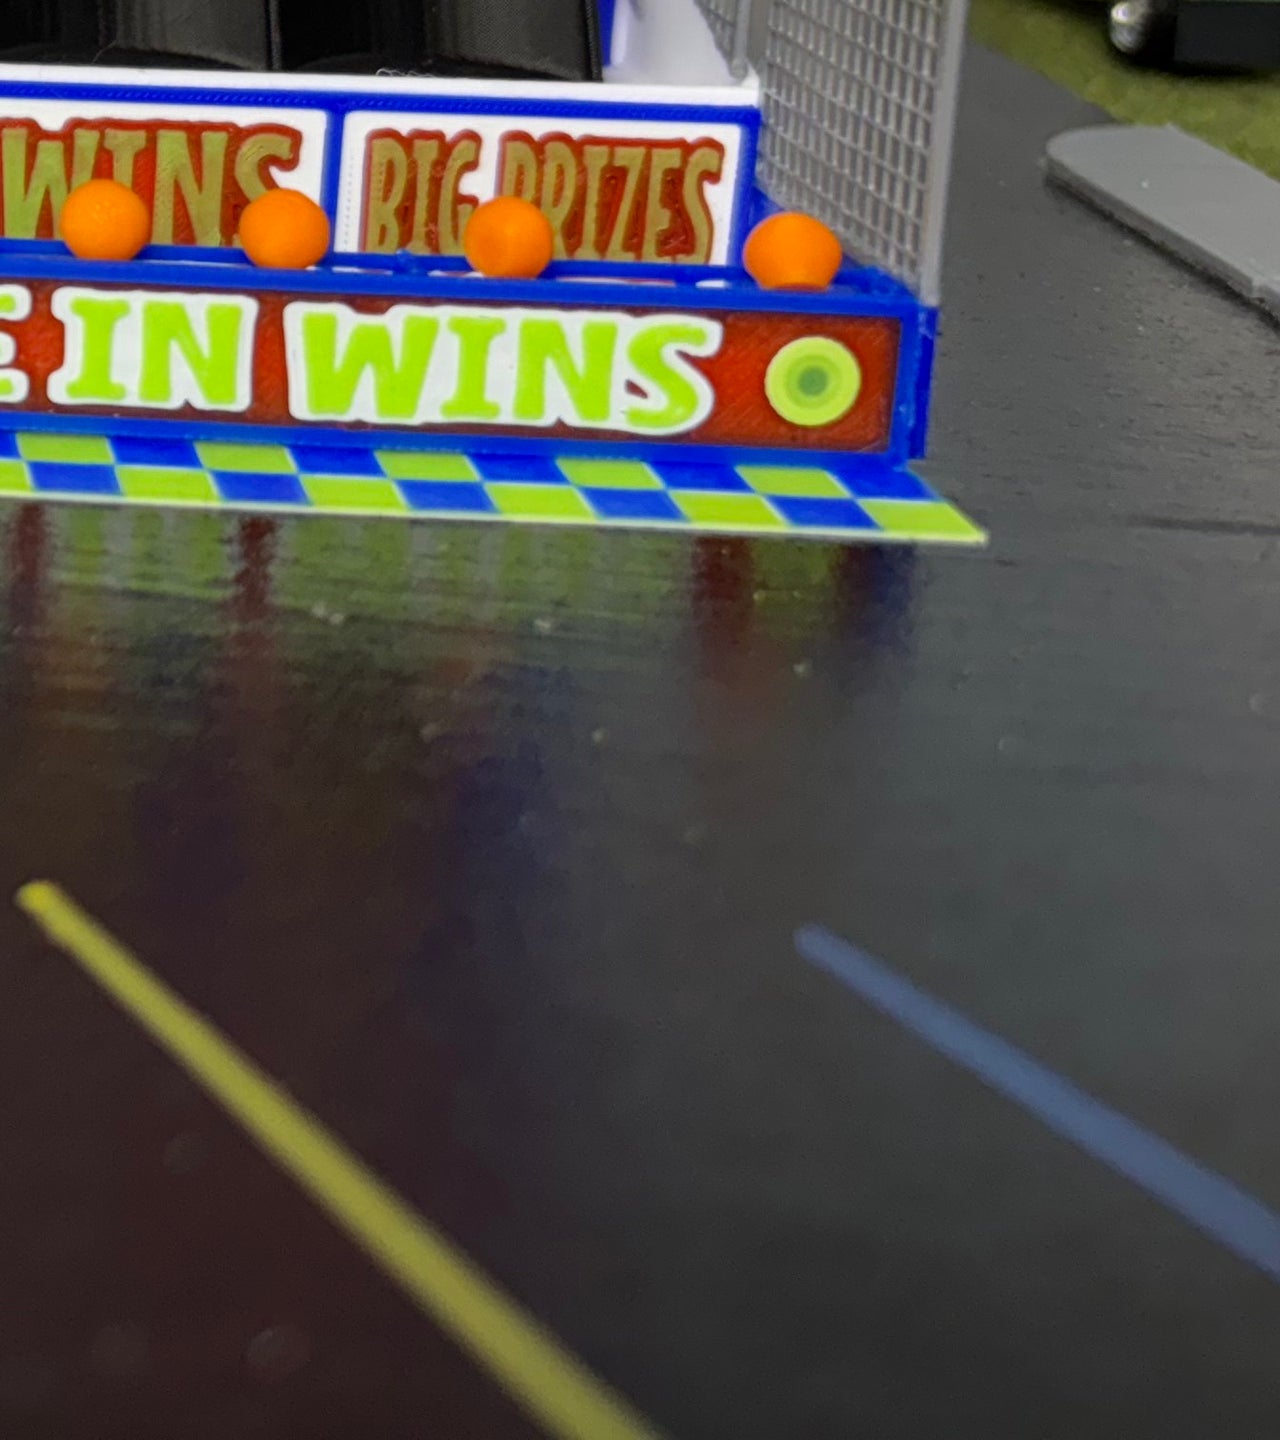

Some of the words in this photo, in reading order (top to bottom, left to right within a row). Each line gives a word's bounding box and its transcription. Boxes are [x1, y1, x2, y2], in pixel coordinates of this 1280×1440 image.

[361, 132, 483, 258] BIG
[498, 136, 726, 268] PRIZES
[61, 294, 248, 409] IN
[298, 308, 712, 432] WINS
